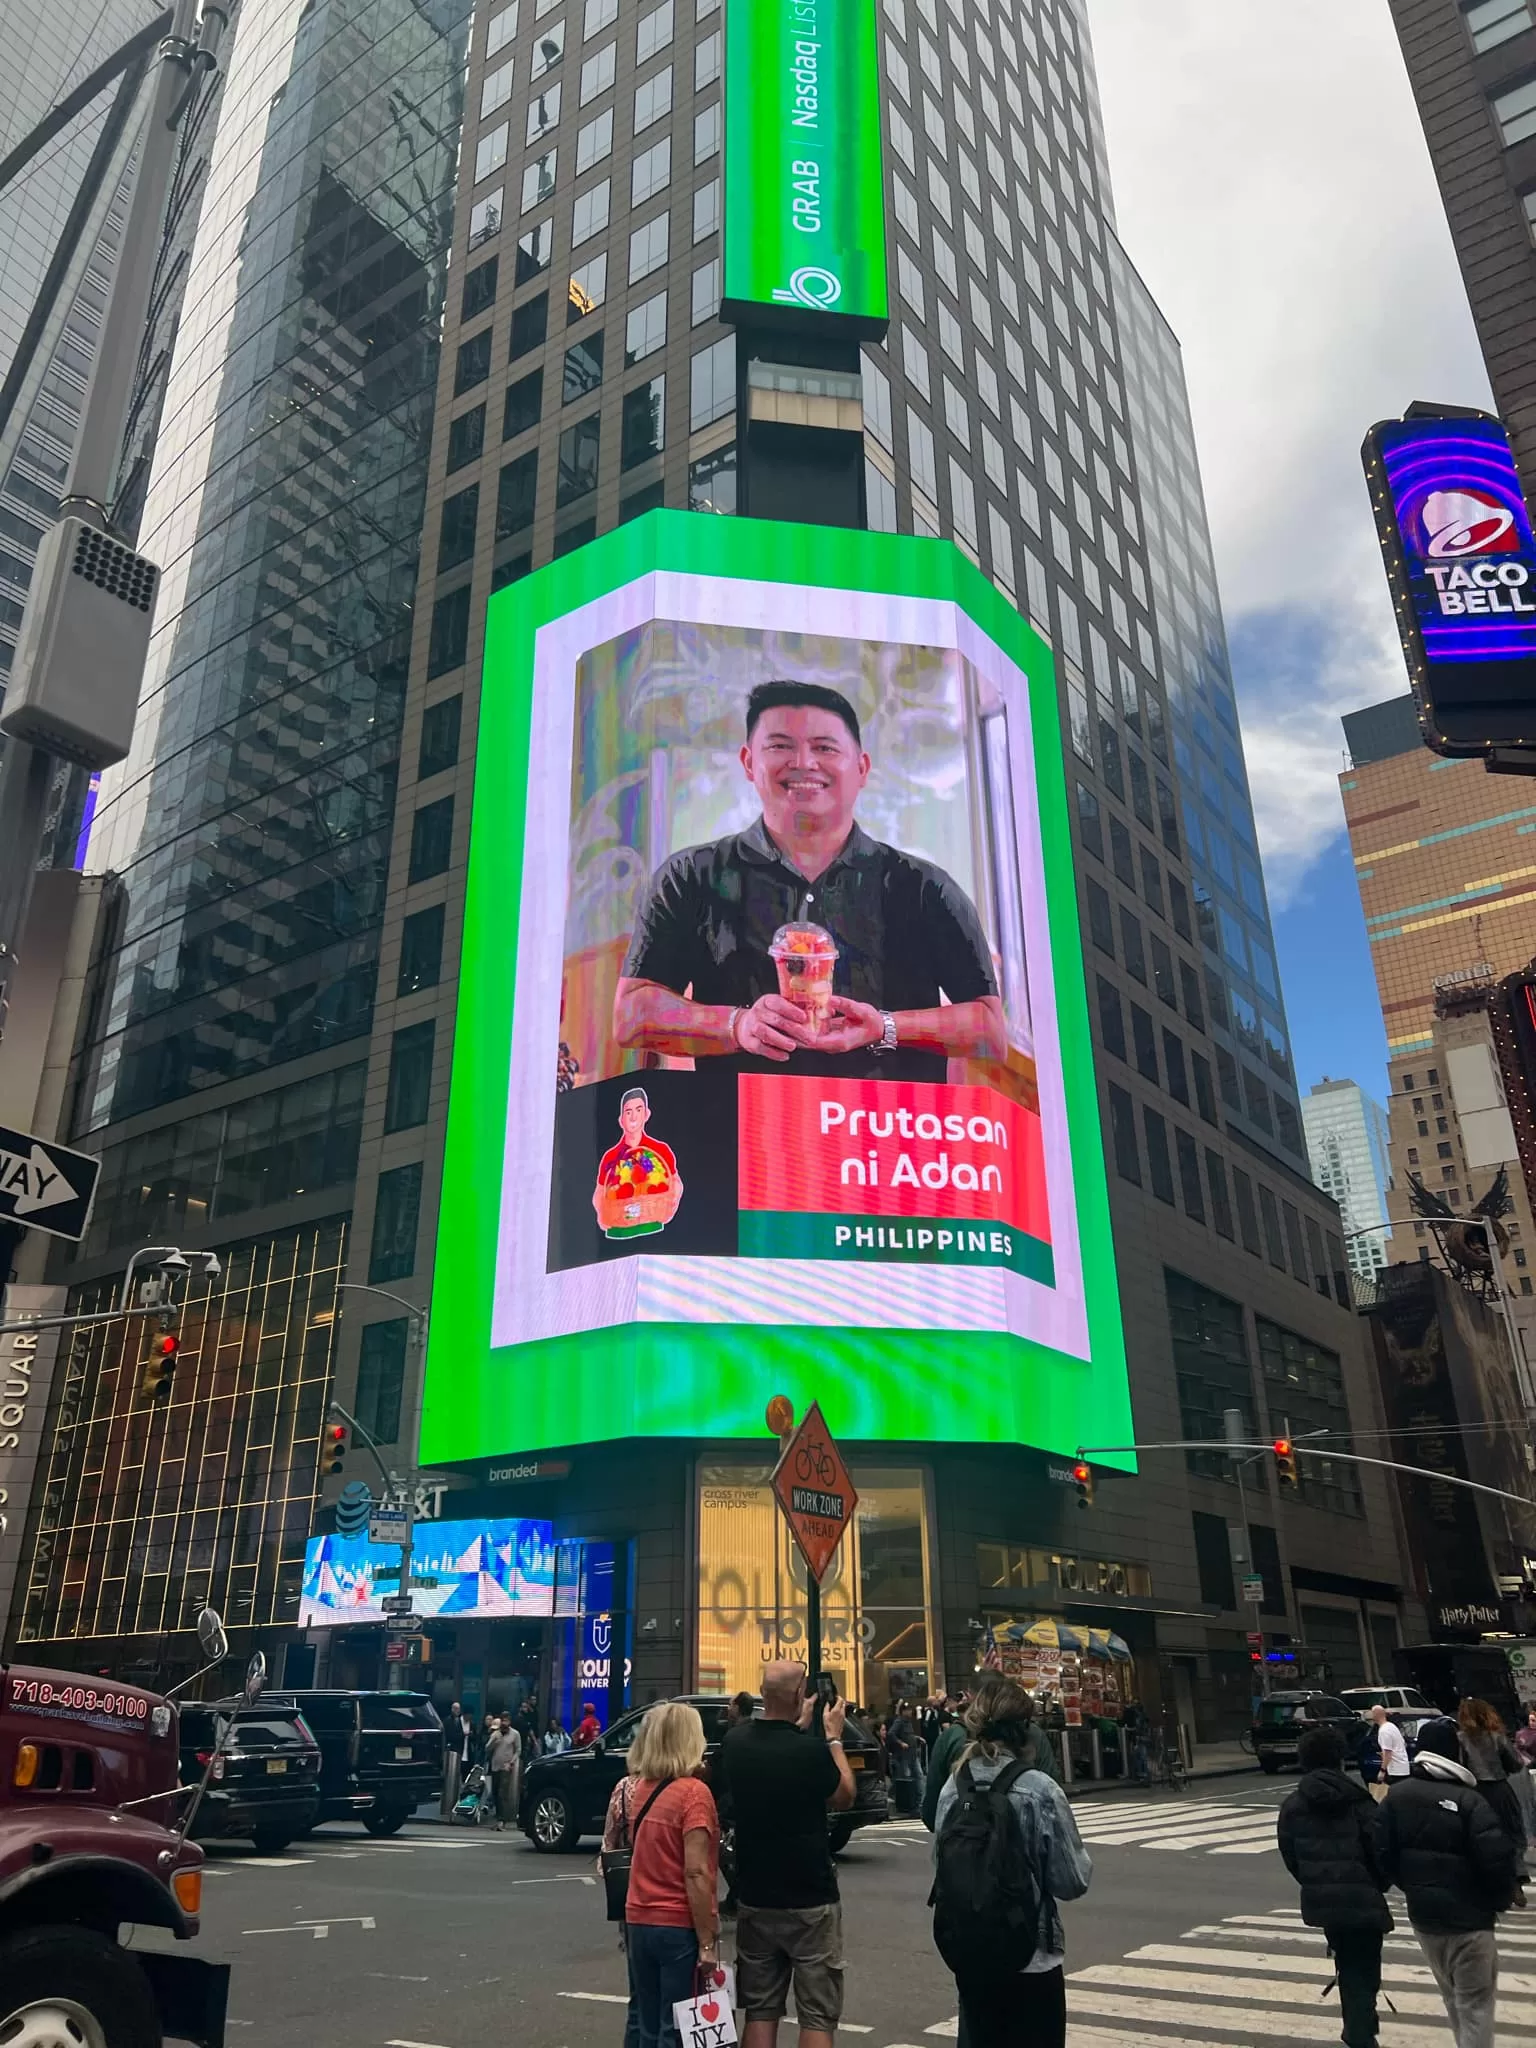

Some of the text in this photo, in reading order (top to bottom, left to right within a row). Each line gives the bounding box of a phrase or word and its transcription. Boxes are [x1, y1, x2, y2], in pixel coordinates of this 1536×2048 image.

[789, 40, 822, 128] Nasdaq
[792, 160, 821, 233] GRAB
[1424, 562, 1529, 591] TACO
[1438, 588, 1536, 616] BELL
[819, 1100, 1008, 1150] Prutasan
[840, 1150, 1003, 1193] ni Adan
[834, 1225, 1013, 1256] PHILIPPINES
[489, 1462, 538, 1482] branded
[1048, 1464, 1078, 1483] brande
[704, 1488, 760, 1499] cross river
[704, 1499, 748, 1510] campus
[793, 1489, 819, 1514] WORK
[820, 1494, 843, 1518] ZONE
[802, 1520, 834, 1538] AHEAD
[1439, 1604, 1501, 1628] Harry Potter
[761, 1646, 874, 1662] UNIVRSITY
[12, 1679, 148, 1719] 718-403-0100
[689, 2006, 702, 2028] I
[690, 2022, 727, 2048] NY
